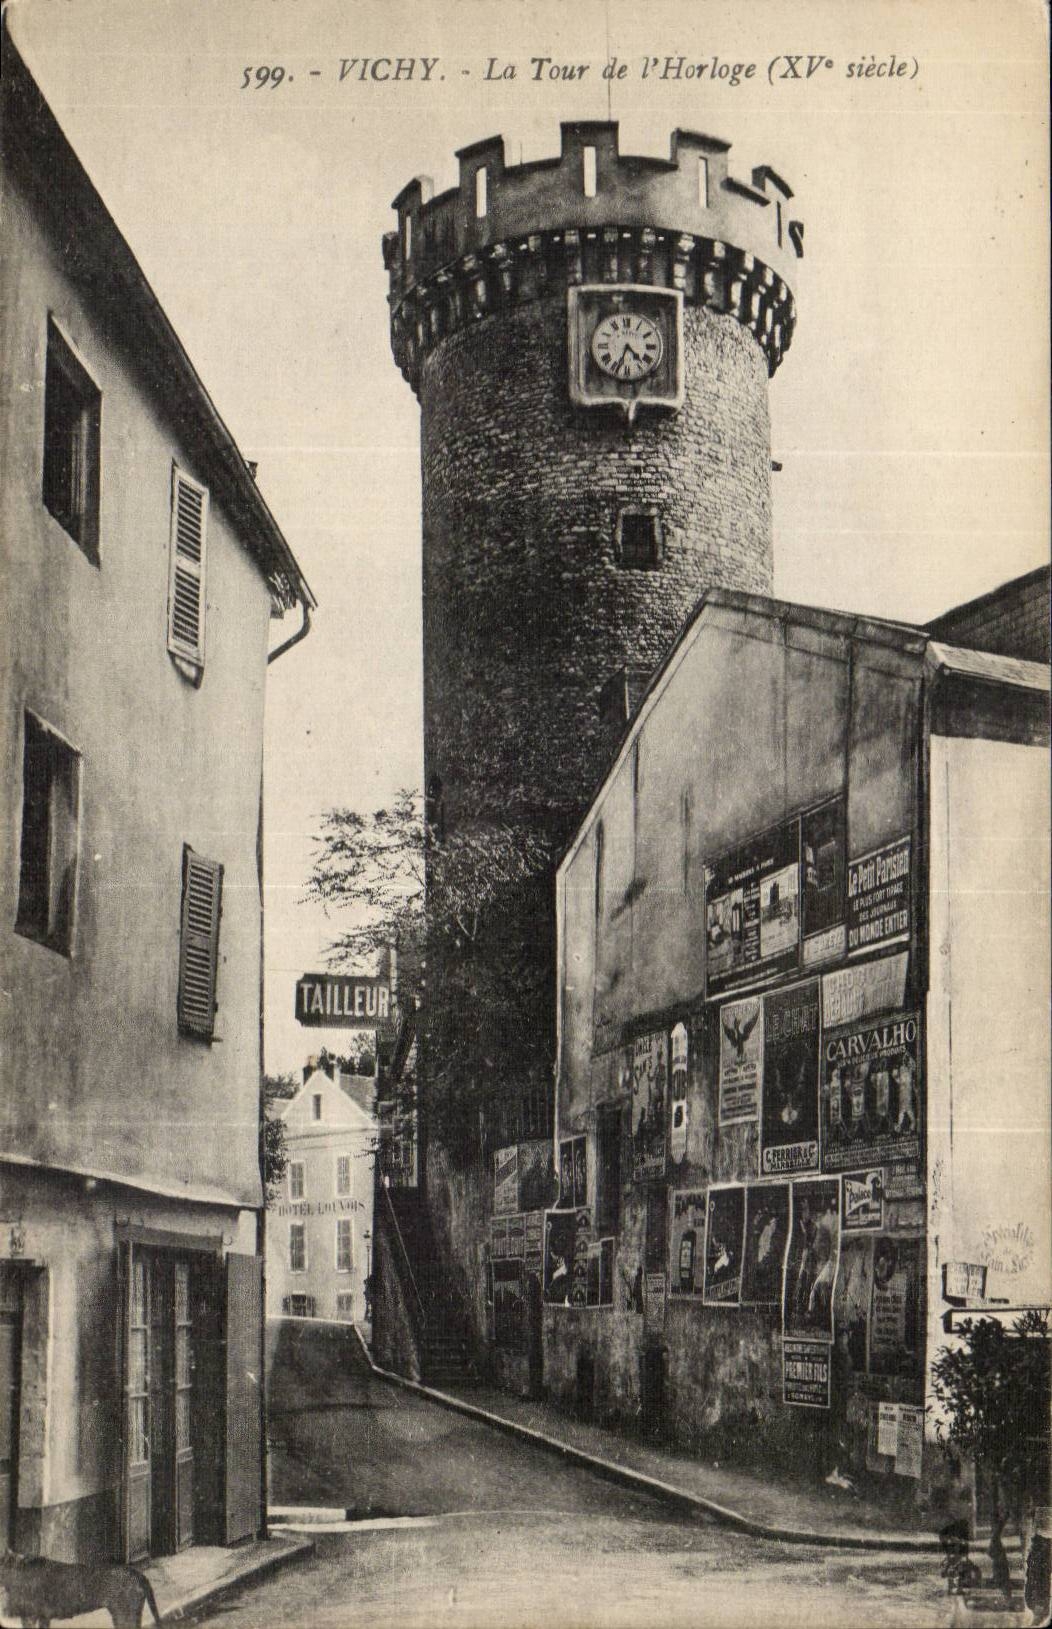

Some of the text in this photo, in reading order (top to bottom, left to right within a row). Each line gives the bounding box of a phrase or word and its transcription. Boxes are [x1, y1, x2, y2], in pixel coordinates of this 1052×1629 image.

[848, 847, 909, 897] Le Petit Parisien
[849, 927, 858, 947] DU
[860, 918, 883, 944] MONDE
[885, 909, 908, 935] ENTIER
[301, 983, 389, 1018] TAILLEUR
[826, 1020, 917, 1061] CARVALHO
[278, 1202, 314, 1216] HOTEL
